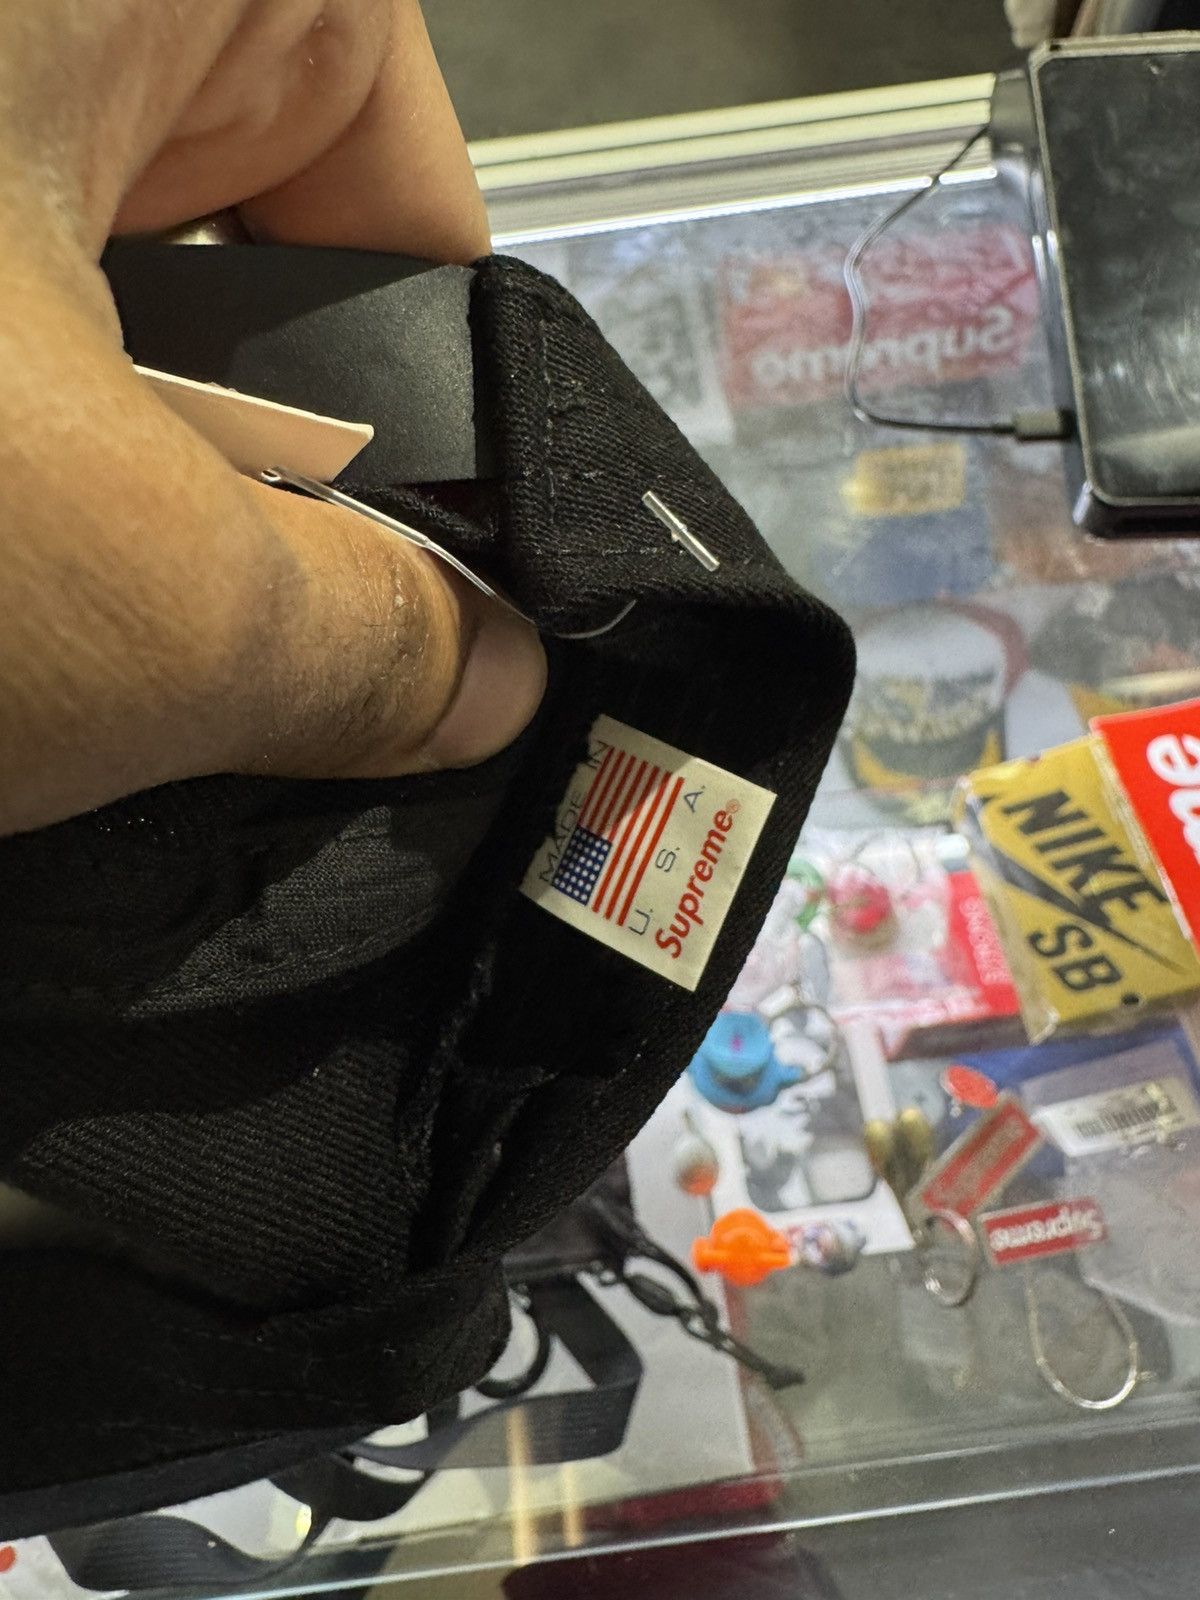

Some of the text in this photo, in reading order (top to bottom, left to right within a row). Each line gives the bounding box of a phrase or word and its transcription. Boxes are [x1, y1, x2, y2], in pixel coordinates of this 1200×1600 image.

[539, 791, 582, 882] MADE
[1002, 790, 1171, 931] NIKE
[1026, 923, 1123, 993] SB
